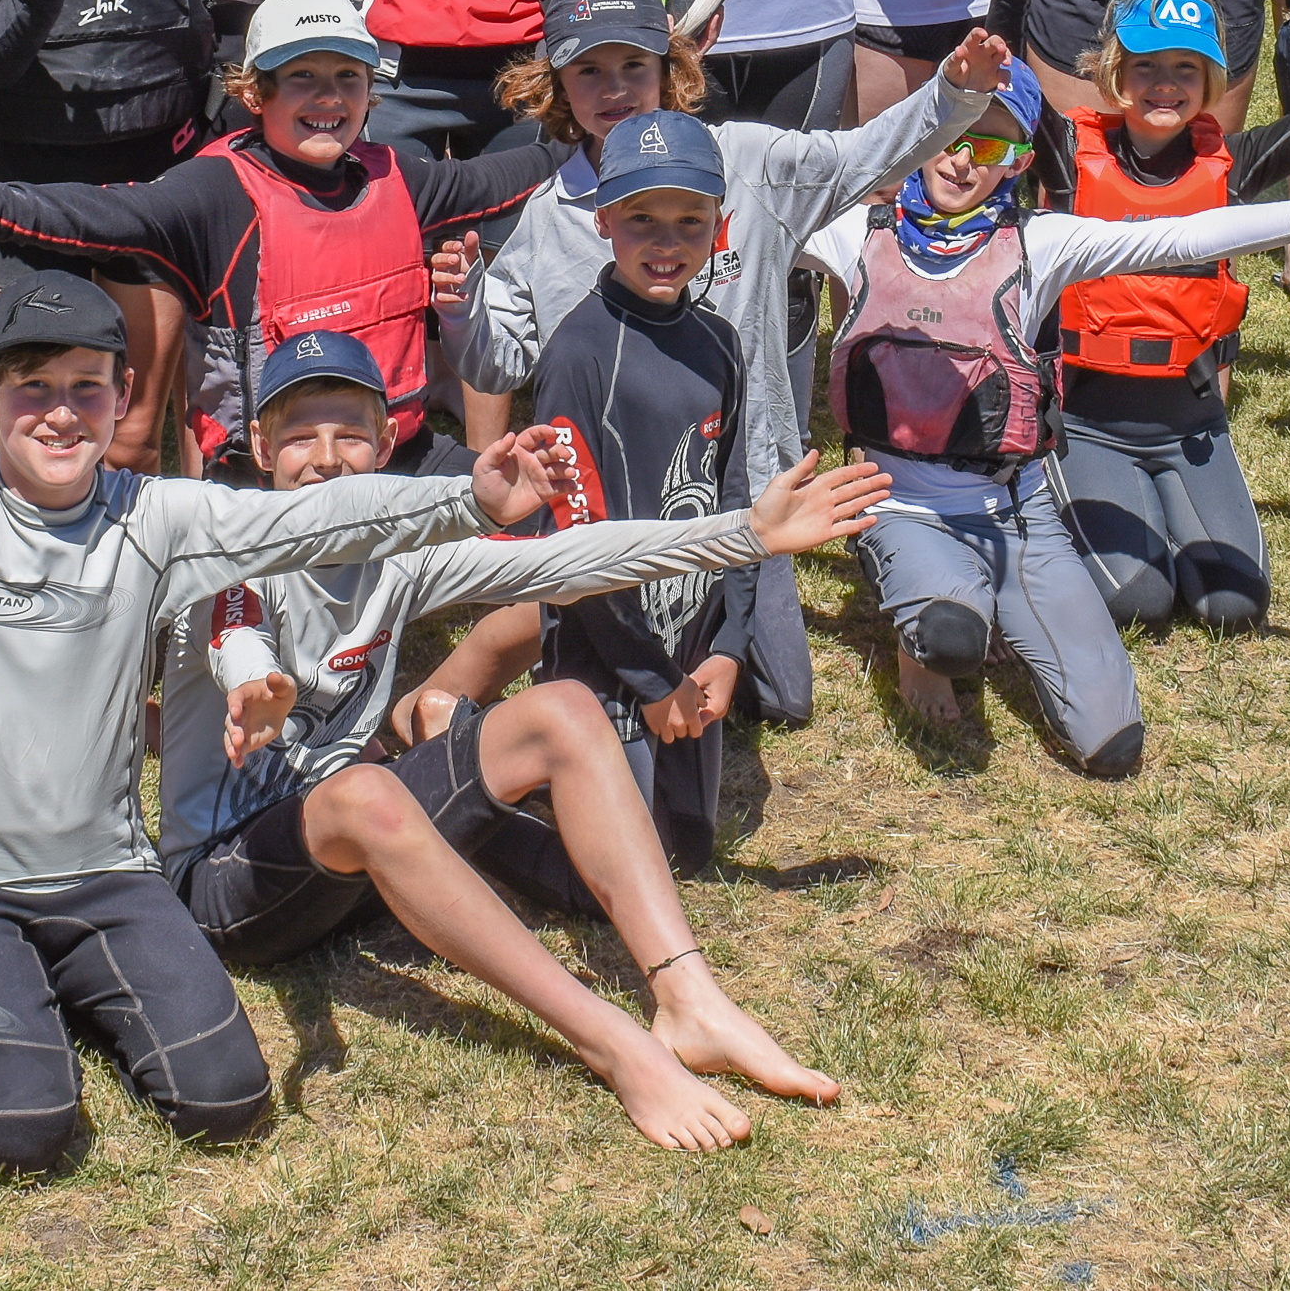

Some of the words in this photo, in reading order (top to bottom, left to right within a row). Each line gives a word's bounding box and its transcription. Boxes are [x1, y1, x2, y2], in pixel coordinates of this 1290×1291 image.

[295, 12, 342, 28] MUSTO
[1159, 0, 1201, 23] AO
[722, 250, 740, 266] SA
[695, 269, 724, 282] SAILNG
[723, 261, 742, 274] TEAM
[906, 305, 943, 324] Gill
